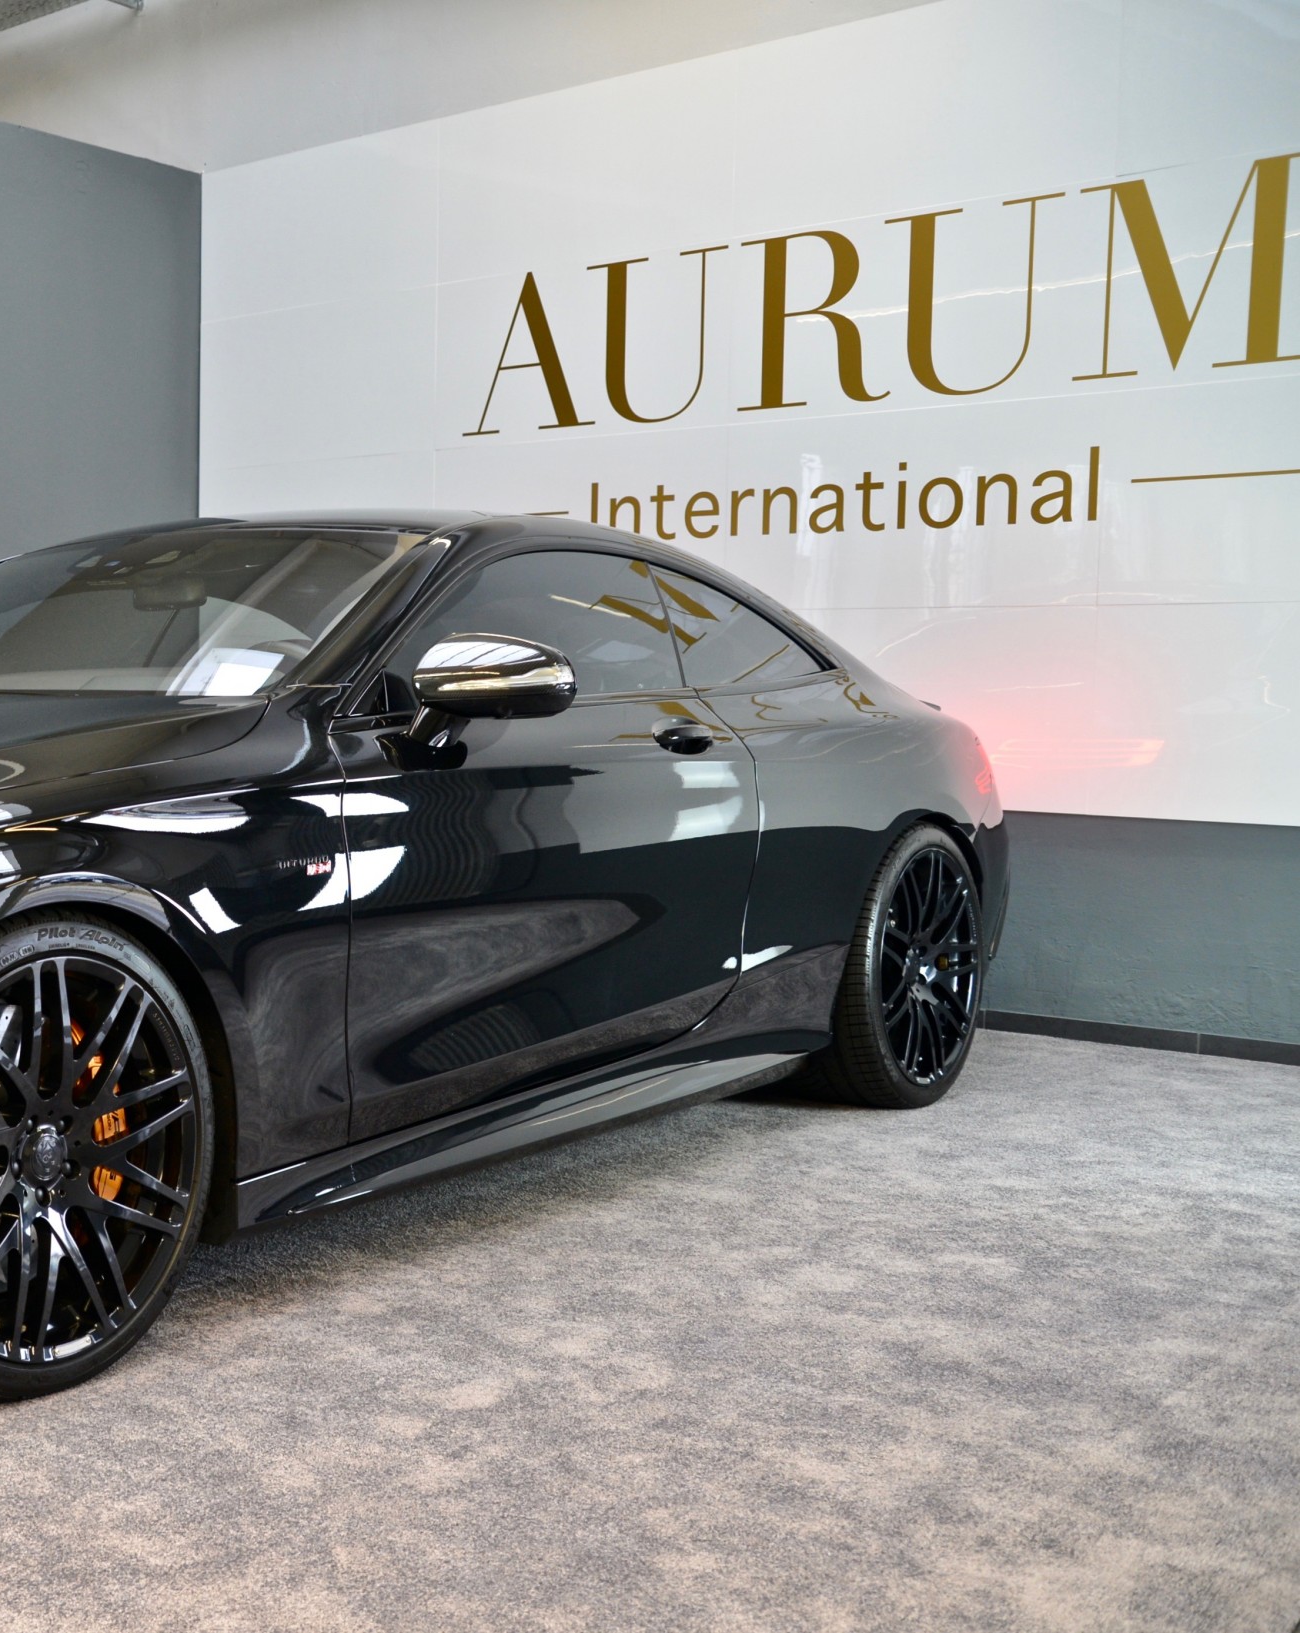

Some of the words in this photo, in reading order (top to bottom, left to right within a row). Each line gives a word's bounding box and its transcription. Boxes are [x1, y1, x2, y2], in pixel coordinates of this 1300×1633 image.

[462, 152, 1300, 437] AURUM
[590, 445, 1101, 541] International
[37, 927, 77, 941] Pilot
